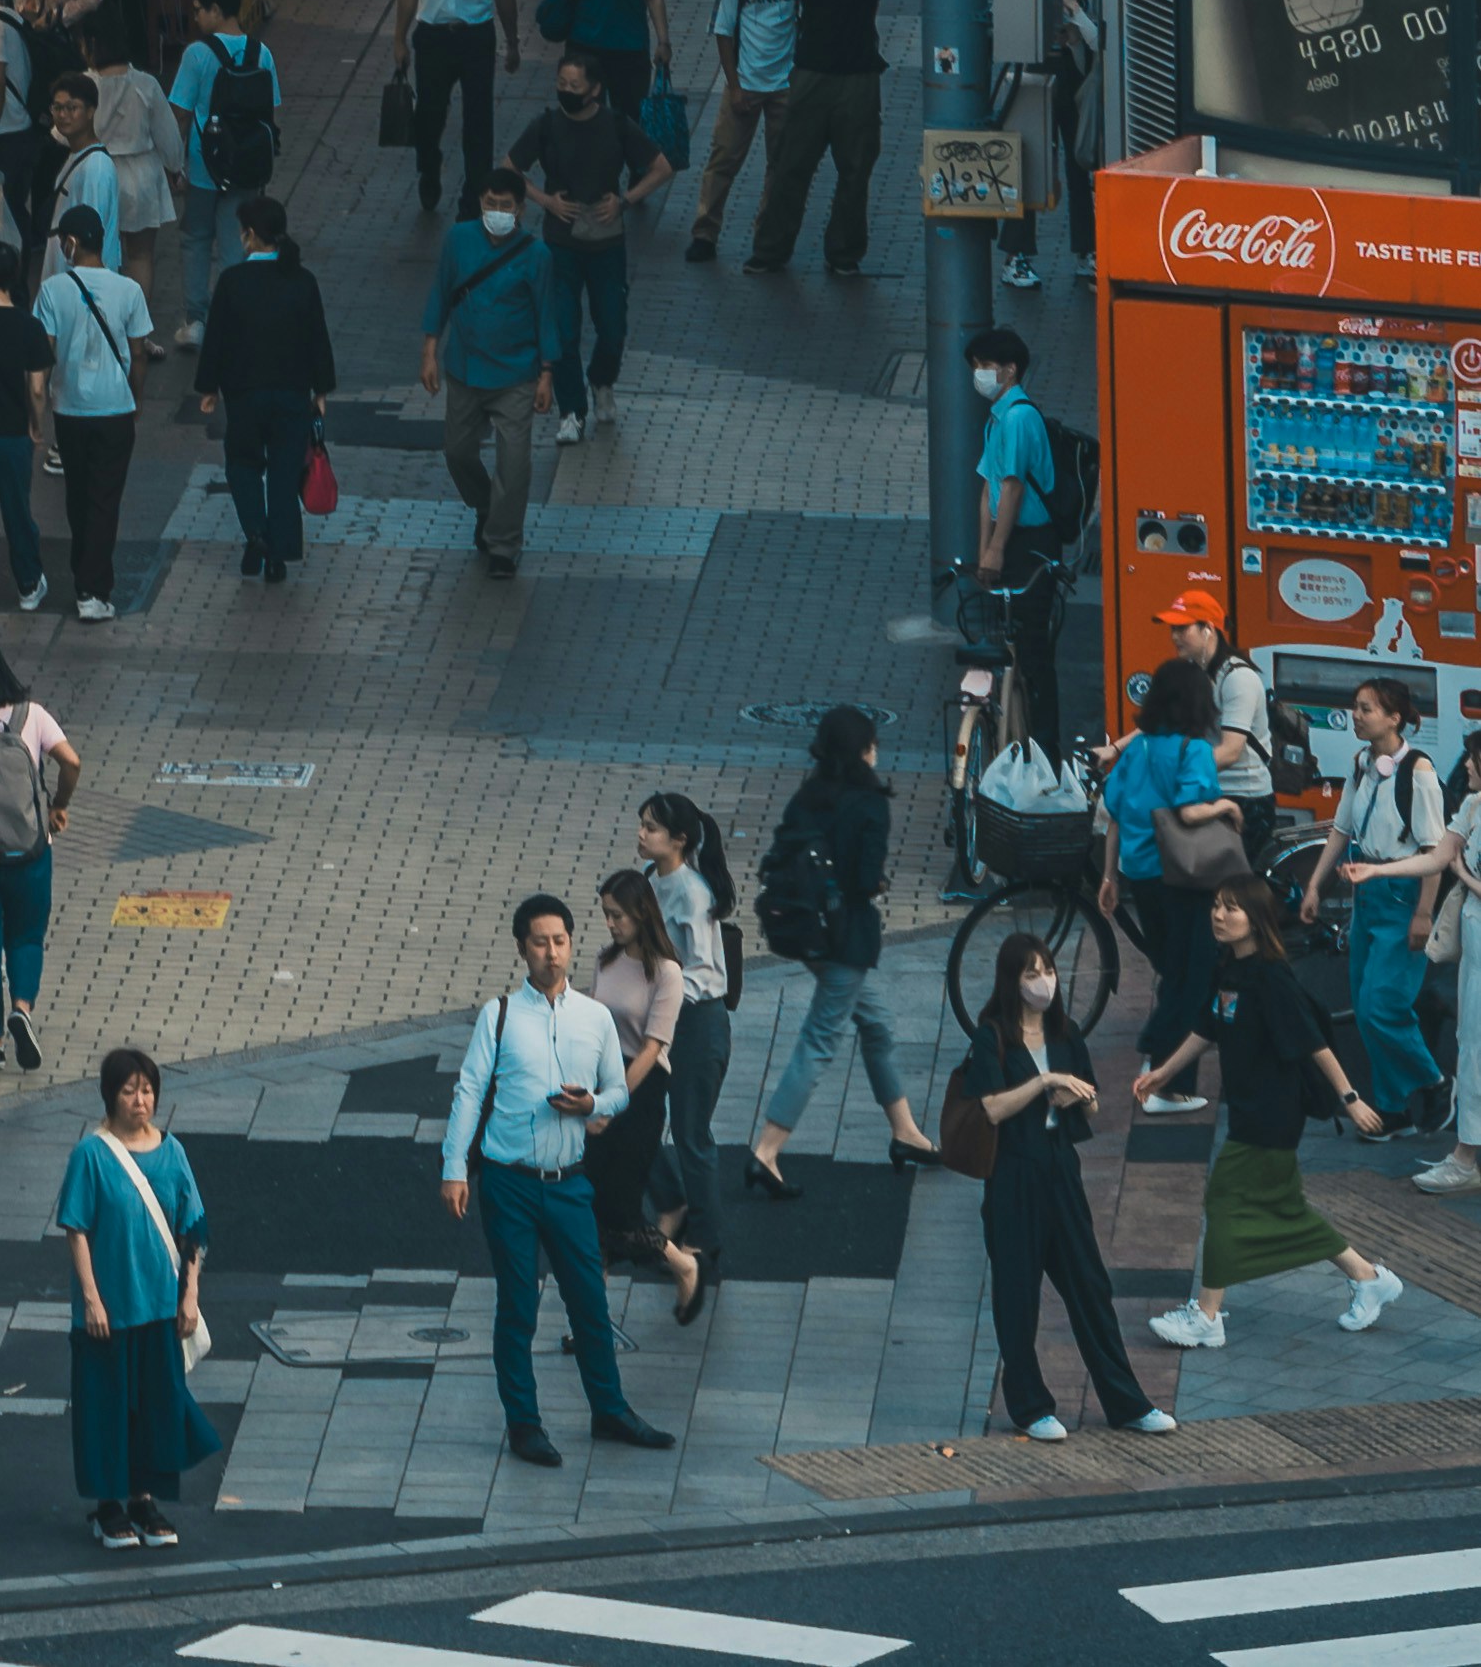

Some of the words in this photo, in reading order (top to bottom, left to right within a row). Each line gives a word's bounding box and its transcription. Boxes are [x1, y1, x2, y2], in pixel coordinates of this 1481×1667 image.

[1298, 25, 1382, 71] 4980
[1170, 208, 1325, 270] Coca-Cola
[1356, 240, 1413, 263] TASTE
[1416, 244, 1451, 265] THE
